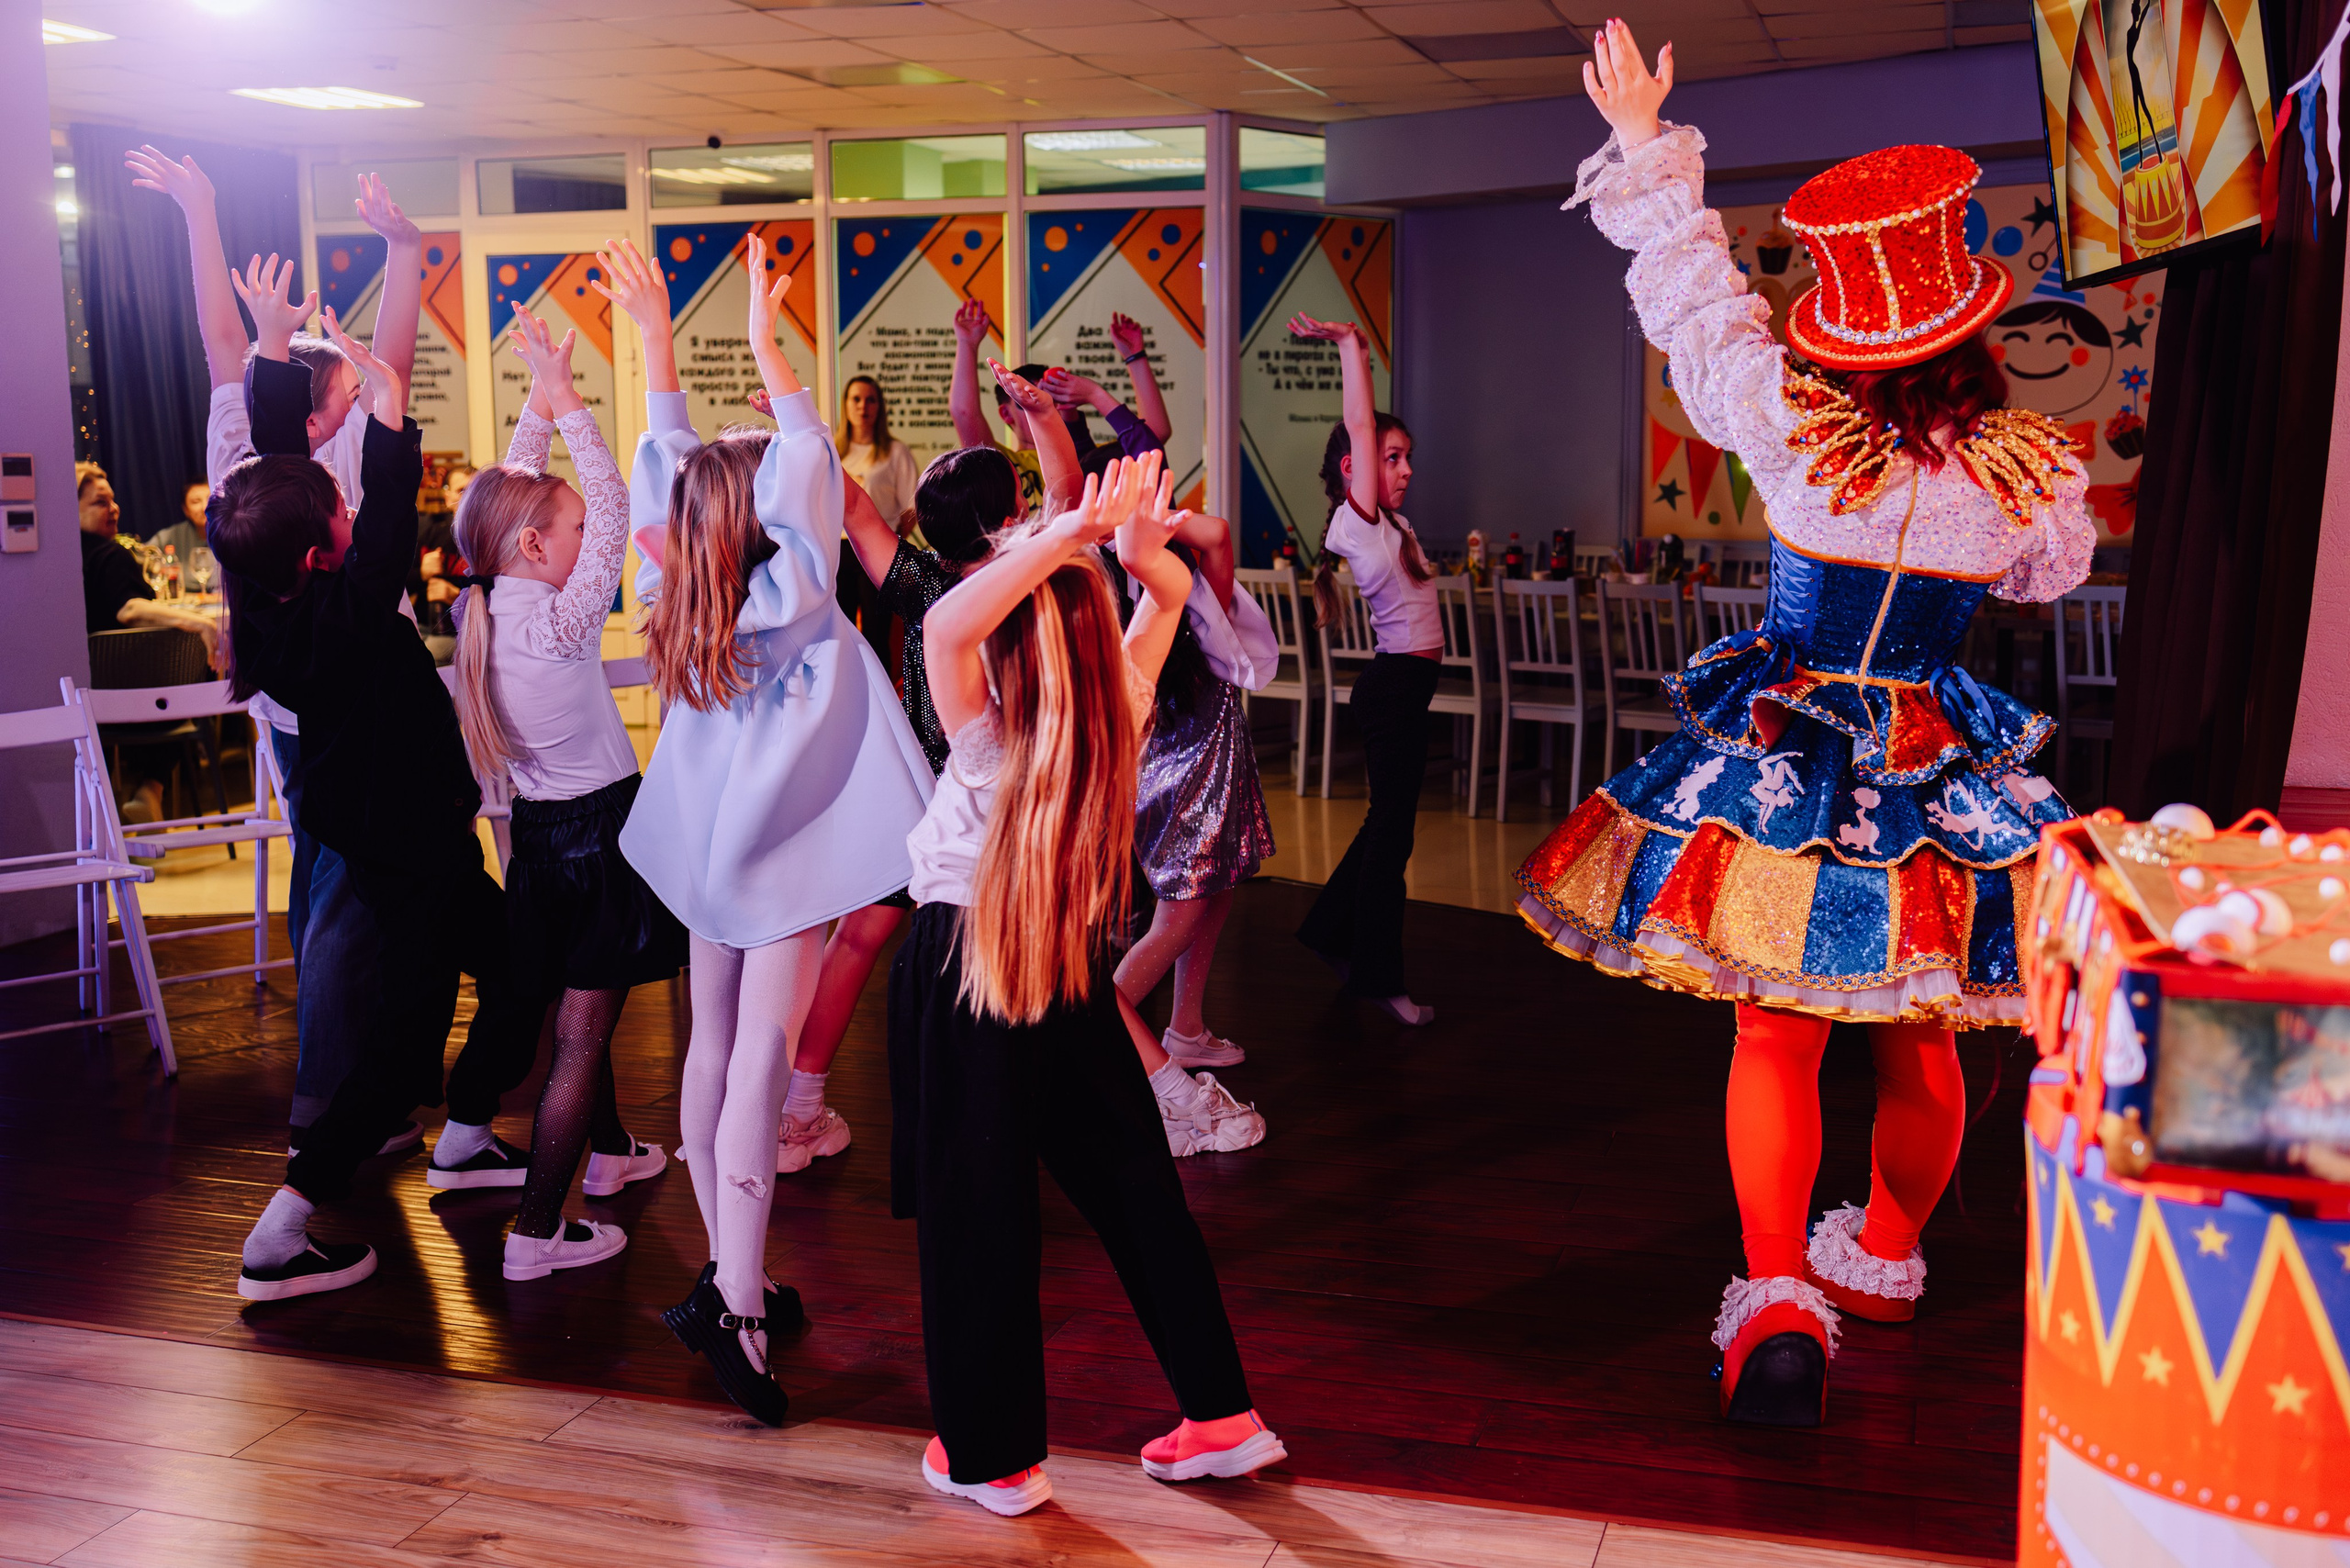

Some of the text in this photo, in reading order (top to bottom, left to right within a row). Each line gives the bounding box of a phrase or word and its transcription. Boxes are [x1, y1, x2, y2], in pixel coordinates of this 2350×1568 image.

[876, 327, 912, 338] Мама,
[1078, 325, 1102, 338] Два
[690, 336, 699, 347] Я
[1079, 353, 1115, 364] твоей
[857, 361, 876, 371] Вот
[879, 361, 910, 371] будет
[924, 363, 952, 371] меня
[1267, 362, 1279, 375] Ты
[1273, 377, 1282, 389] А
[691, 383, 739, 395] просто
[917, 397, 949, 405] магаз
